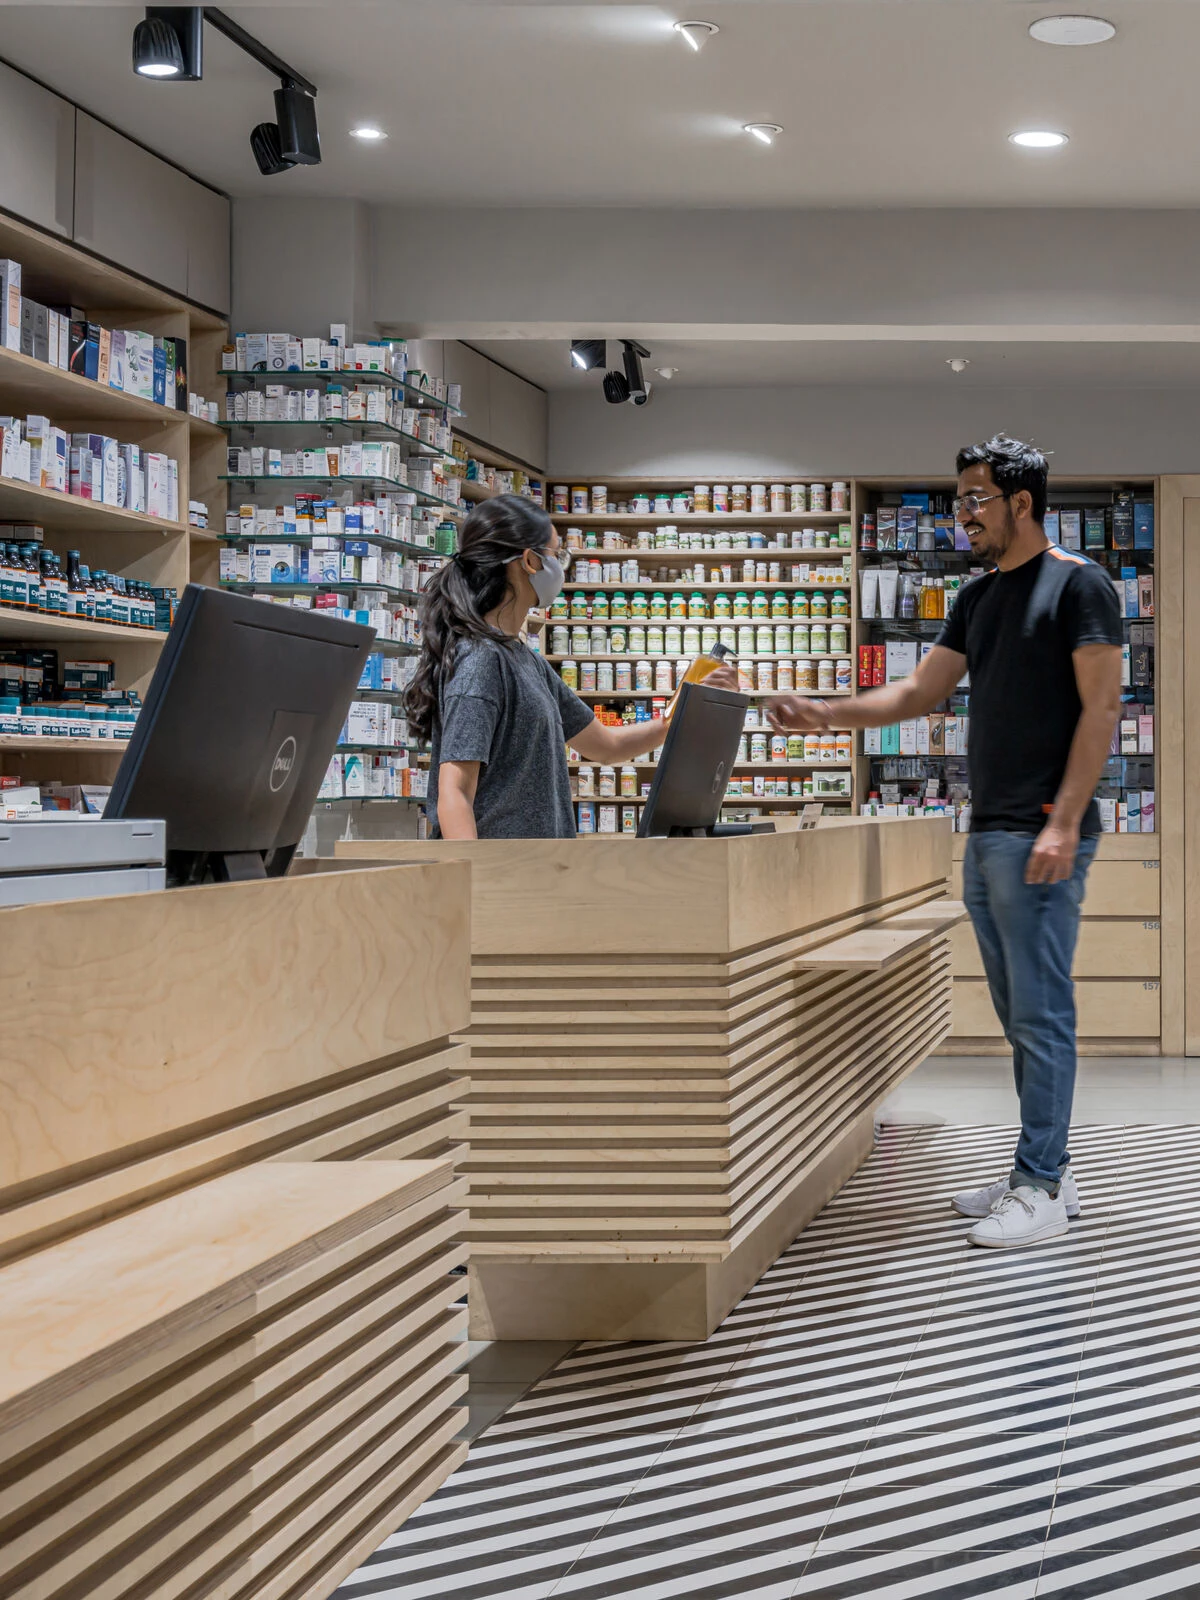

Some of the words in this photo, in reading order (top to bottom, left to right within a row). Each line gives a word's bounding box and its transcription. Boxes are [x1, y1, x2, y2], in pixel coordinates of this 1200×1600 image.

[274, 757, 292, 771] DELL
[1142, 860, 1160, 869] 155
[1142, 921, 1160, 930] 156
[1142, 981, 1160, 991] 157
